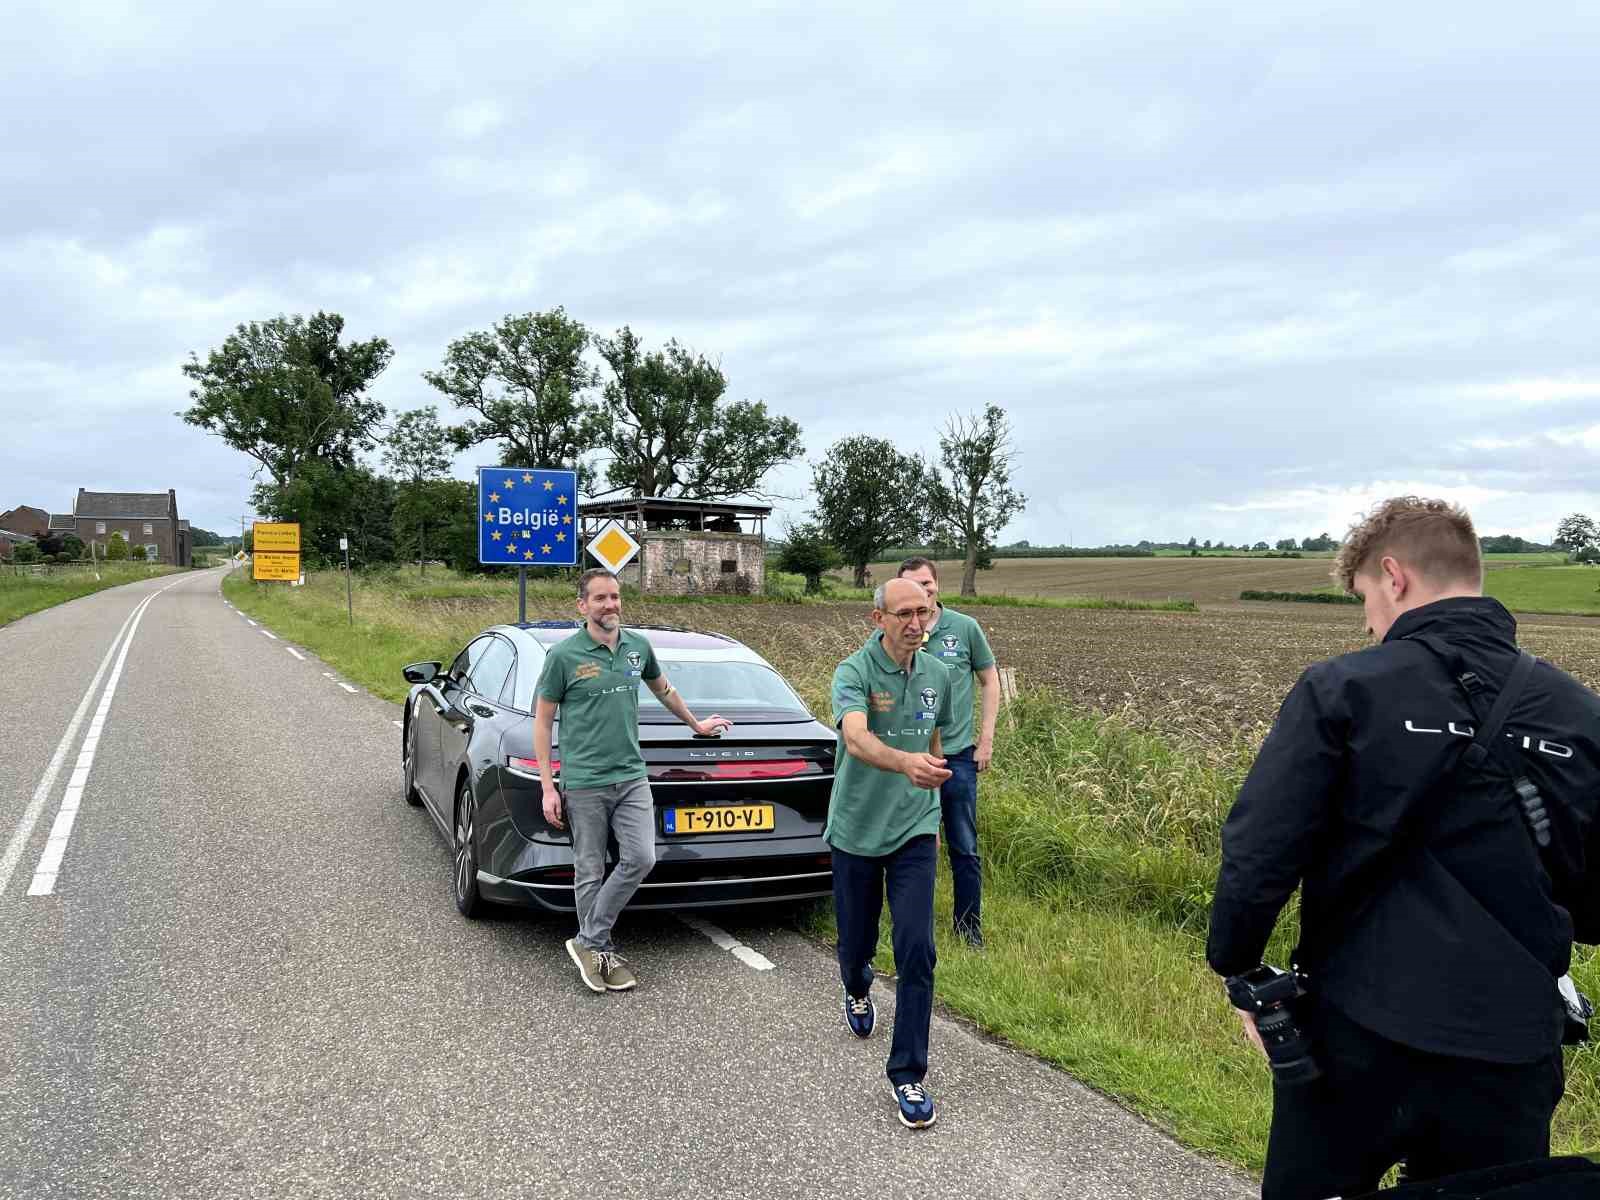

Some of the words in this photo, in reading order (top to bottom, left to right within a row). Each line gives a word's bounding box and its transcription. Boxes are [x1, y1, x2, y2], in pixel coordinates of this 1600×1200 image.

[498, 507, 559, 530] België
[588, 685, 633, 697] LUCI
[1404, 719, 1574, 758] LUID
[685, 809, 763, 829] T-910-VJ
